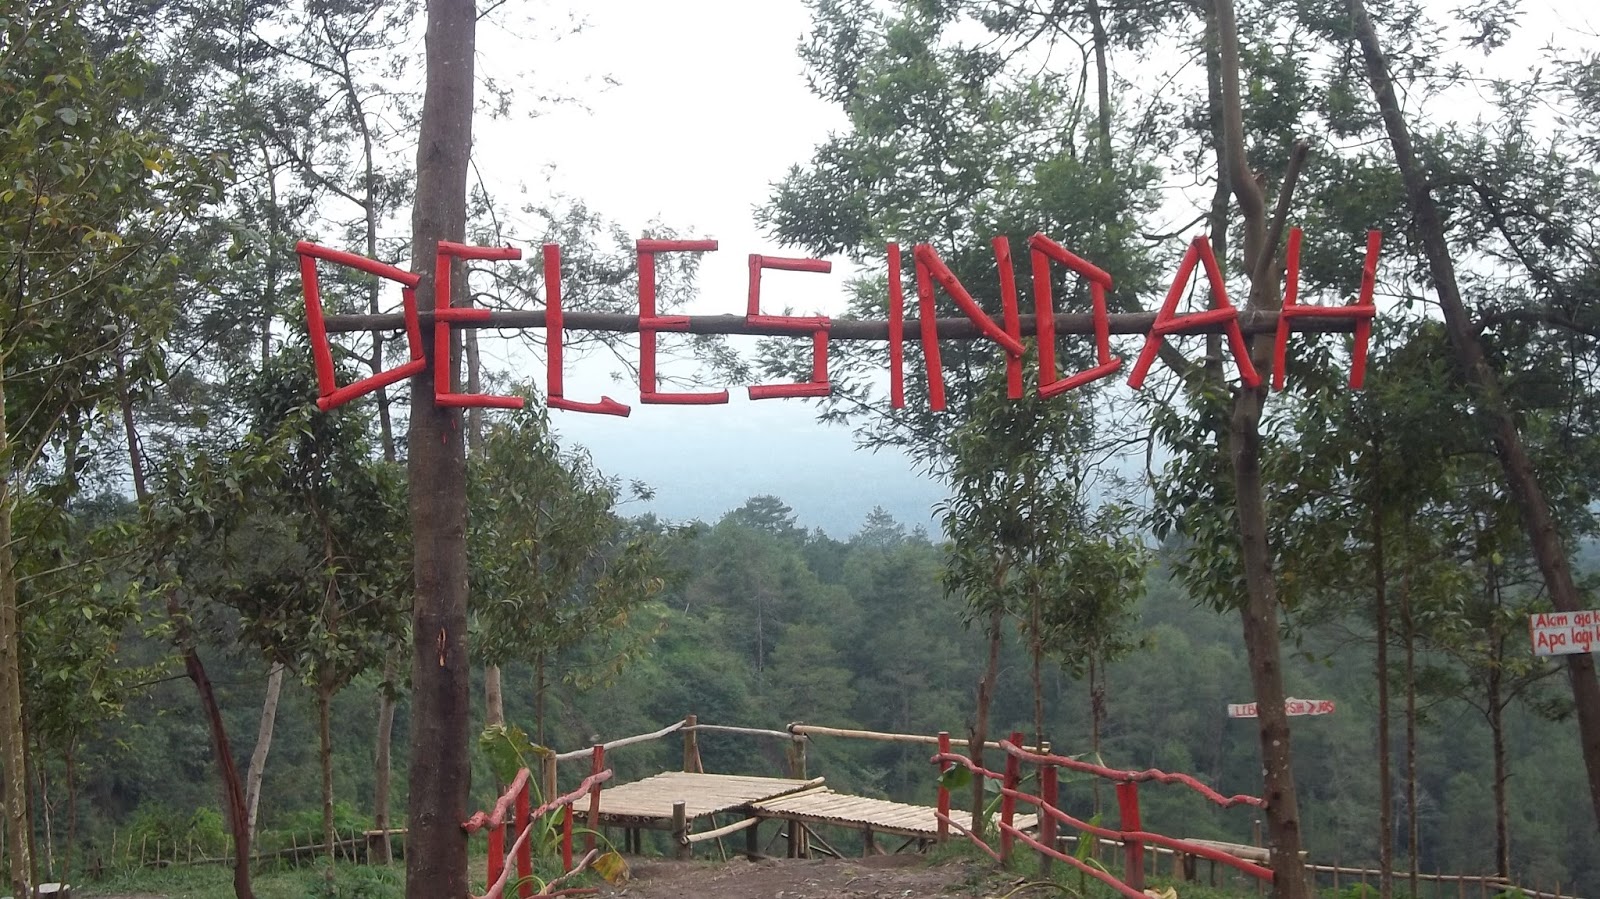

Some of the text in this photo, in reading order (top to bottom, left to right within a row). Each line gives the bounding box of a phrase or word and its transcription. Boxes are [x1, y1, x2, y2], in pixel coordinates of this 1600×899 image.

[296, 228, 1382, 418] DELES INDAH
[1574, 613, 1591, 627] aja
[1538, 631, 1566, 653] Apa
[1571, 627, 1593, 652] lagi
